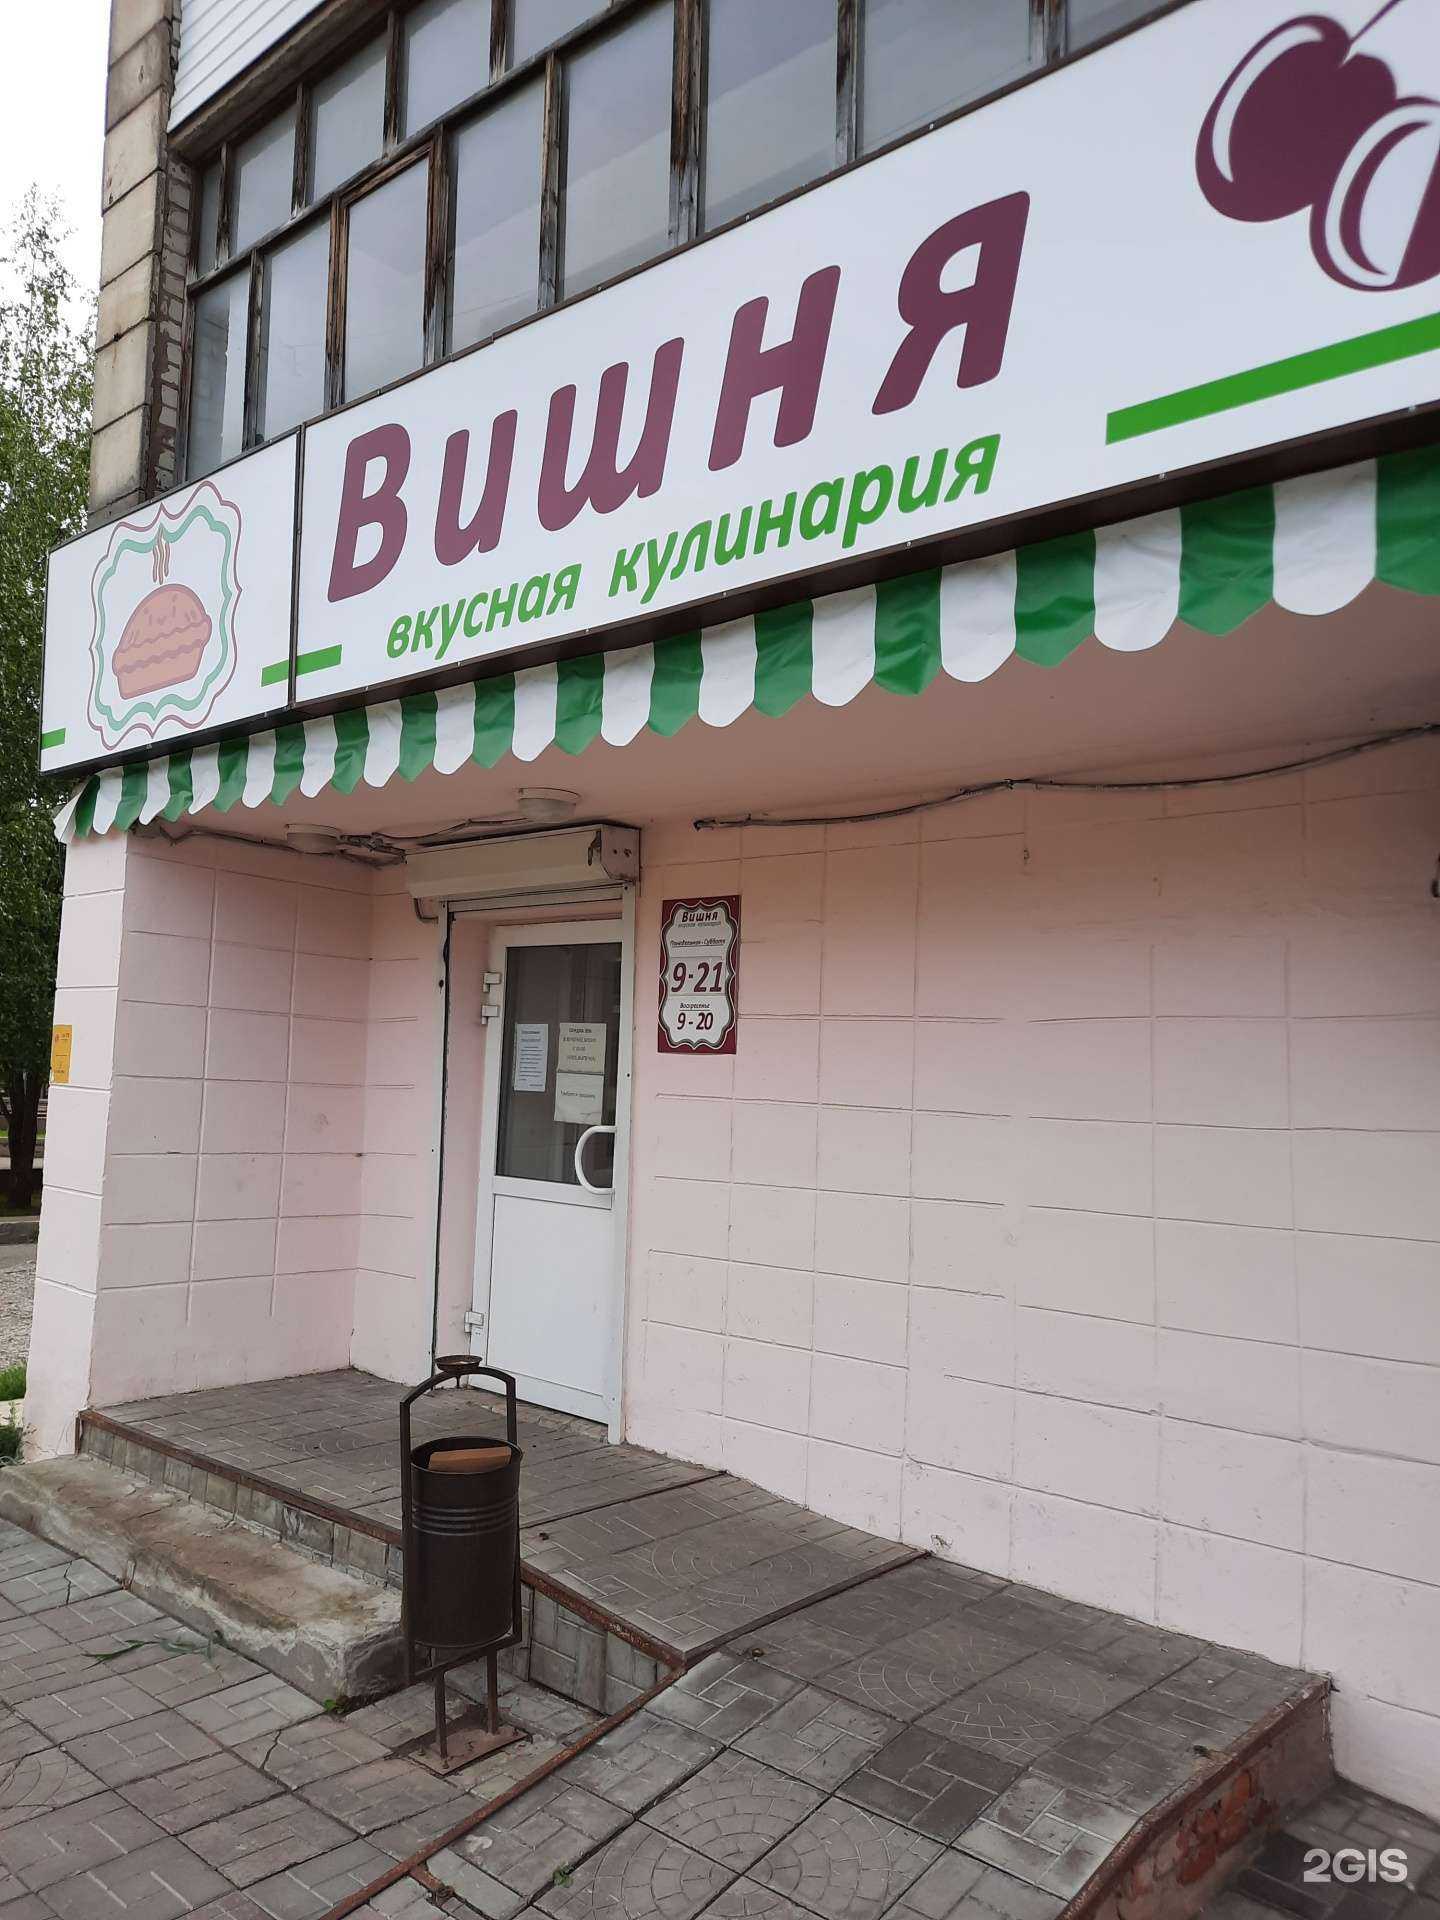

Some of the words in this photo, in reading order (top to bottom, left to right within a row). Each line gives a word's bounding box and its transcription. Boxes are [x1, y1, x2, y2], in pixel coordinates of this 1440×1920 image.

[327, 191, 1031, 602] Вишня
[385, 564, 582, 659] вкусная
[606, 435, 1001, 603] кулинария
[682, 911, 719, 923] Вишня
